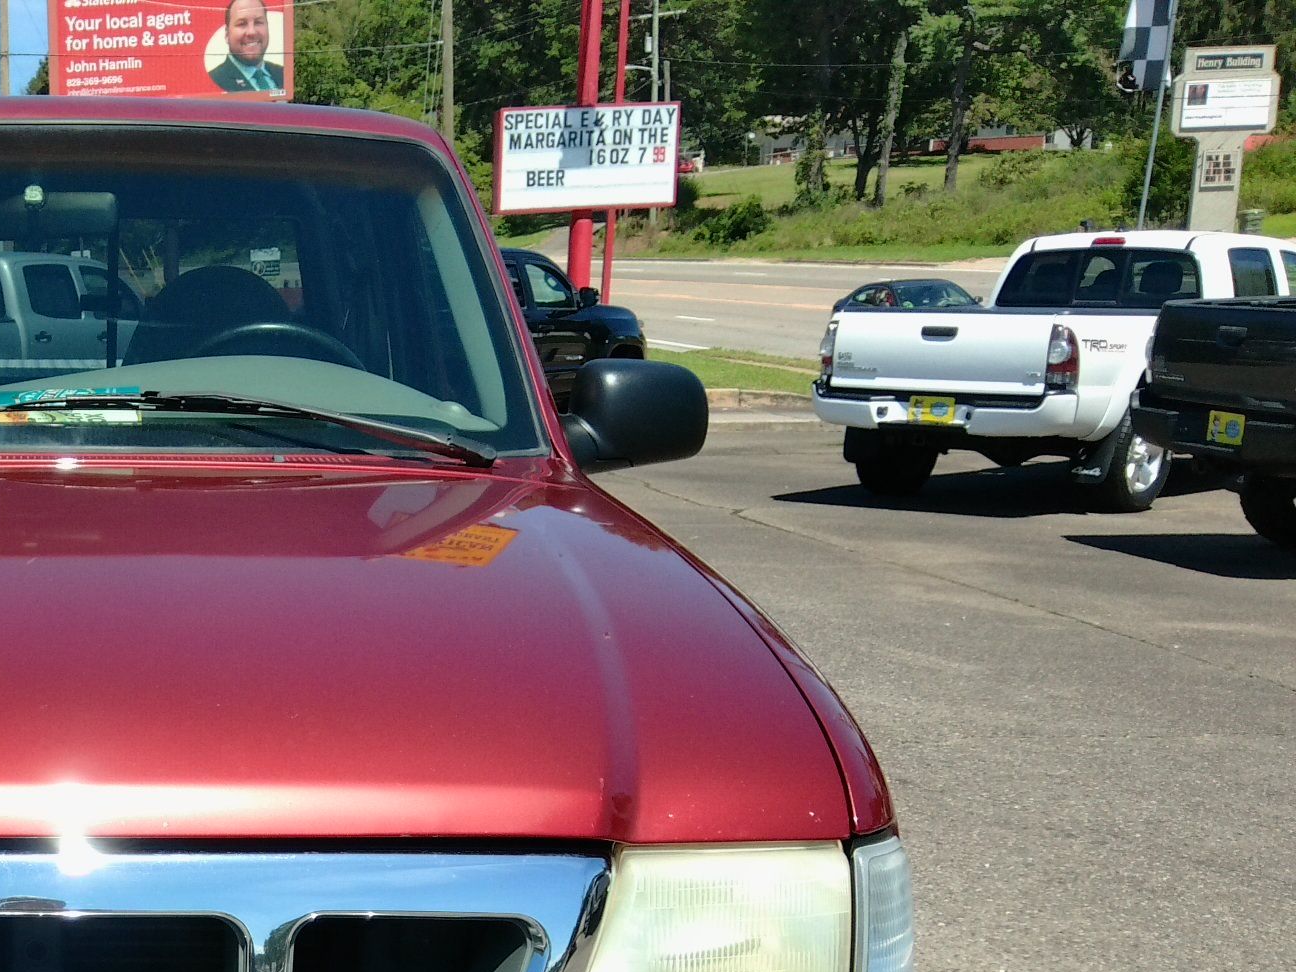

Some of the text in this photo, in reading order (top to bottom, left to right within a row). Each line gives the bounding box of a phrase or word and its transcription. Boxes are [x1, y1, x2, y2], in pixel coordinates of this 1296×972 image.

[65, 10, 191, 32] Your local agent
[65, 30, 194, 51] for home & auto
[66, 57, 142, 73] John Hamlin
[1197, 56, 1261, 69] Henry Building
[505, 111, 572, 131] SPECIAL
[642, 107, 676, 125] DAY
[509, 127, 668, 150] MARGARITA ON THE
[526, 170, 565, 187] BEER
[1082, 339, 1108, 352] TRD
